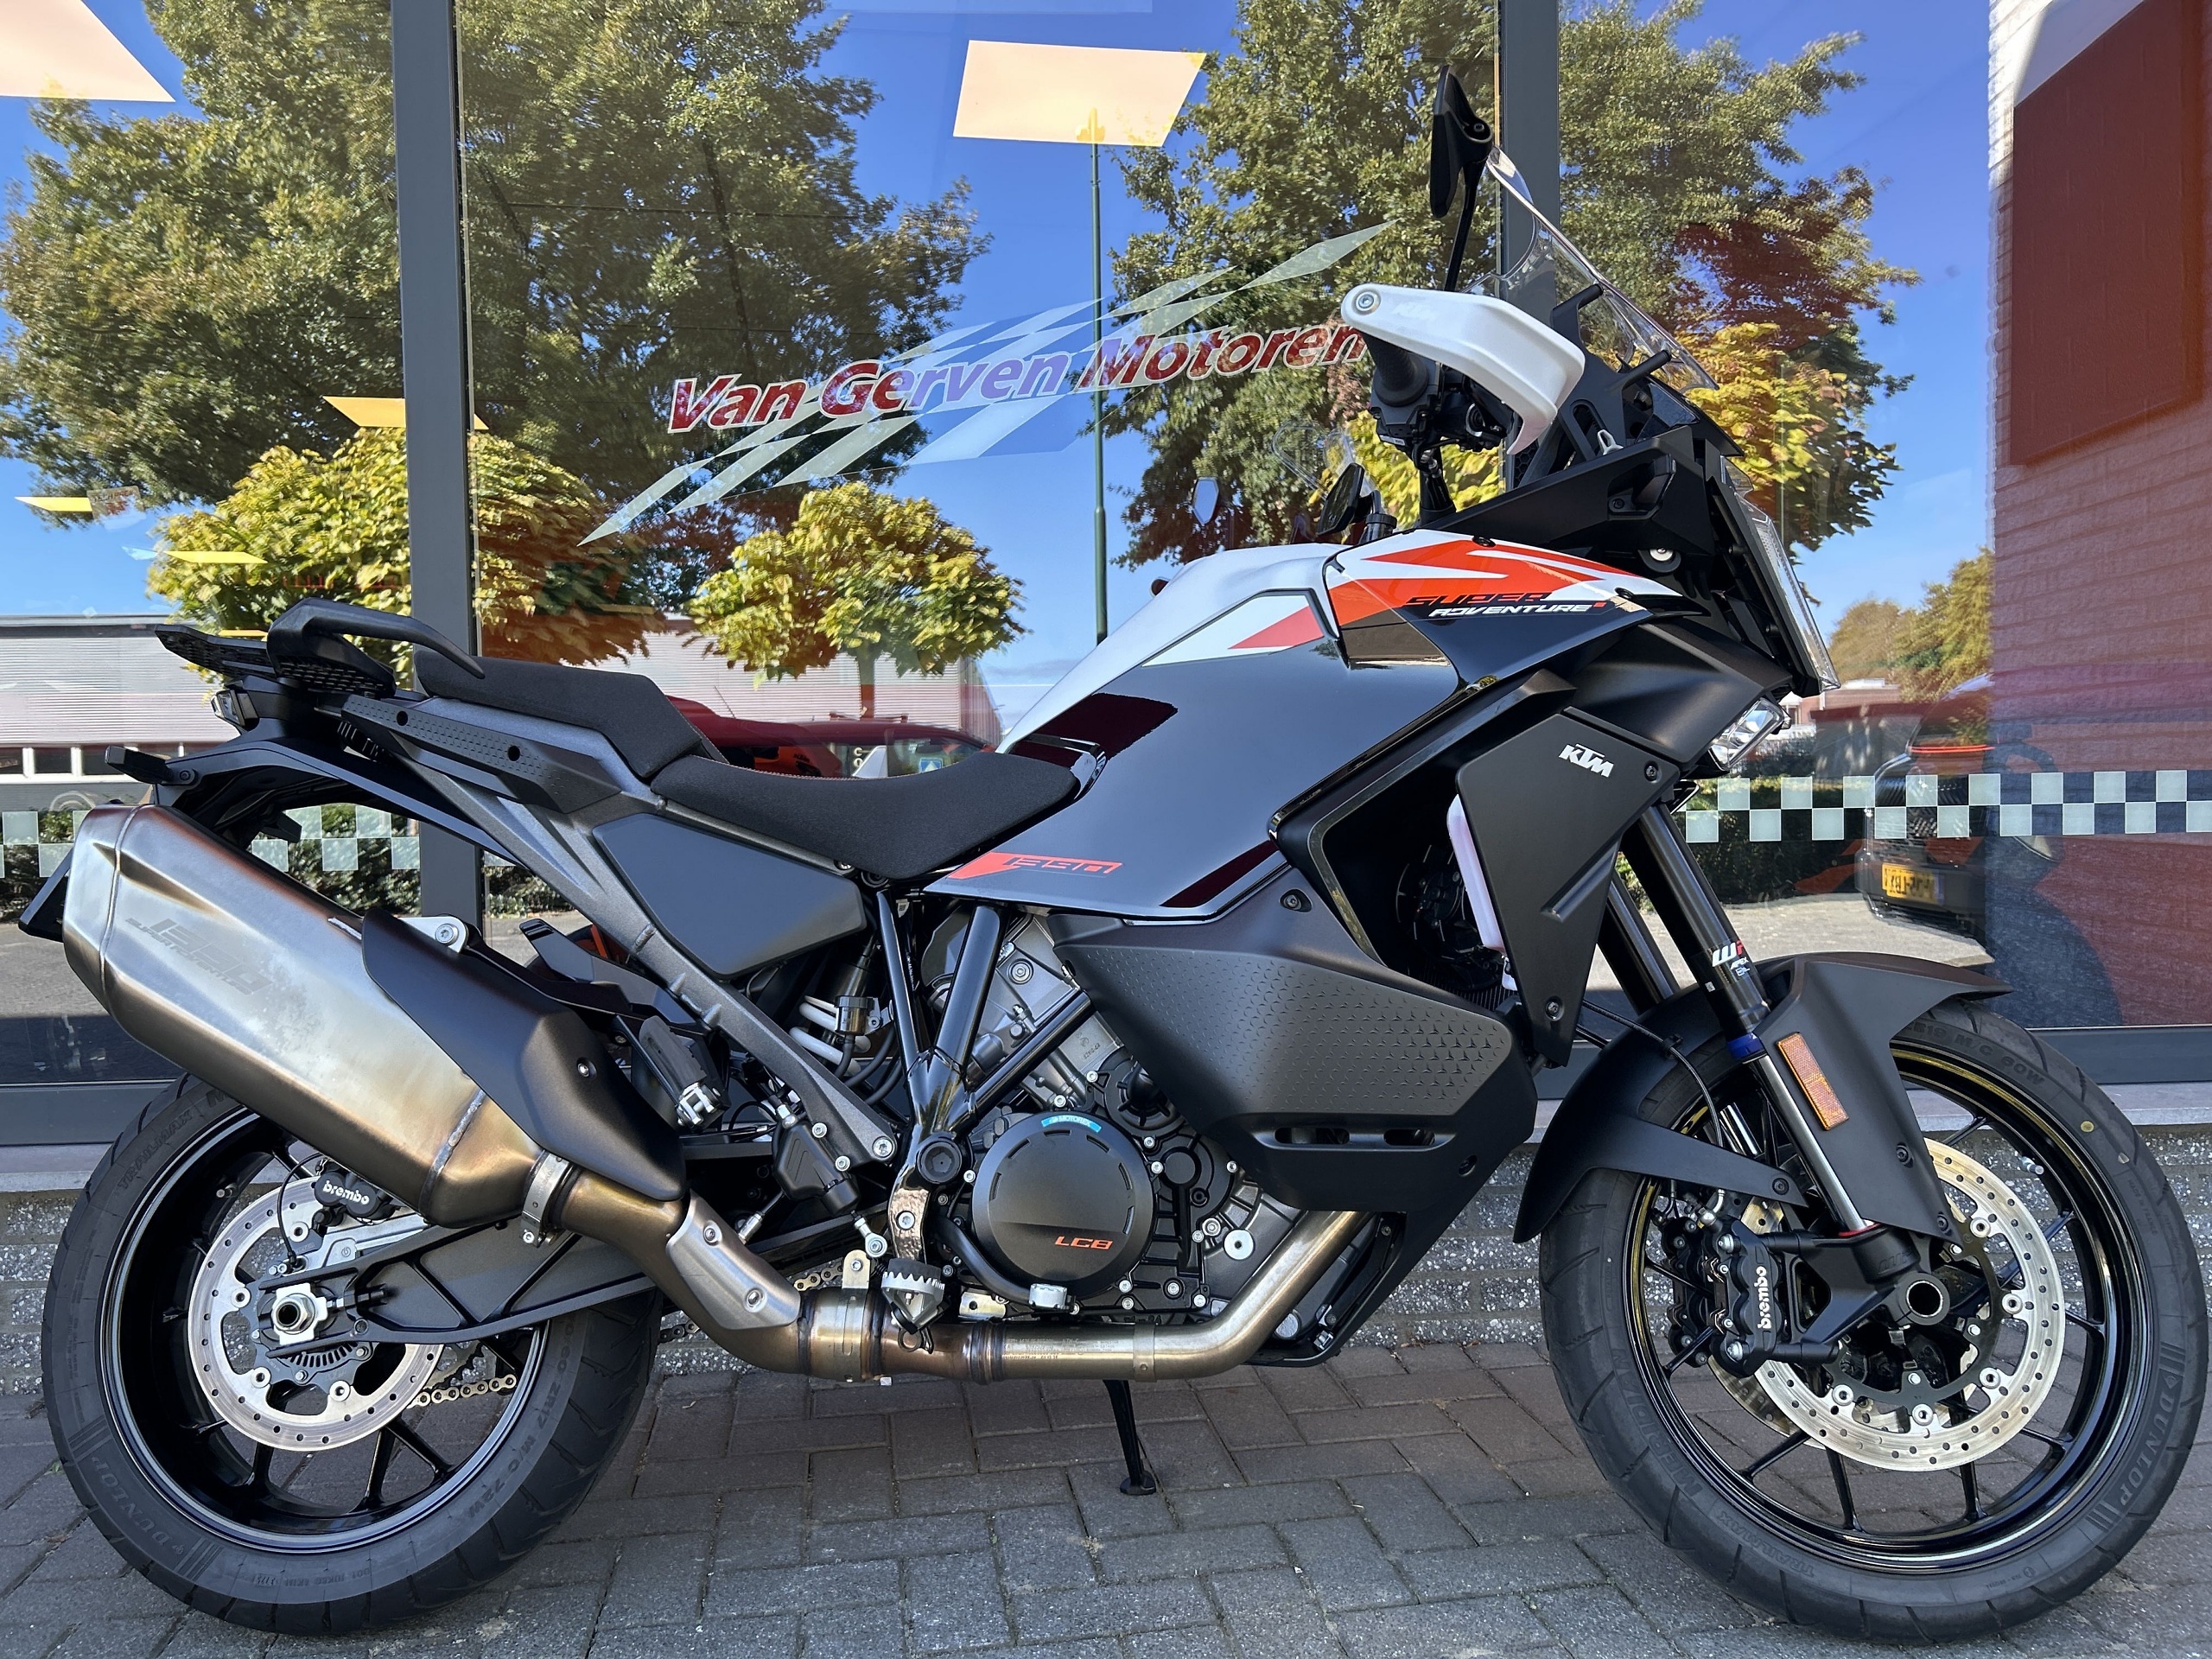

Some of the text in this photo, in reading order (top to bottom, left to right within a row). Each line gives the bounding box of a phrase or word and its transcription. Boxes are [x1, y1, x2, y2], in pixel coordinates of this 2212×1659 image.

[668, 322, 1367, 434] Van Gerven Motoren
[1406, 592, 1554, 606] SUPER
[1427, 603, 1593, 618] ADVENTURE
[1559, 743, 1614, 779] KTM
[117, 1110, 194, 1190] TRAILMAX
[322, 1180, 371, 1205] brembo
[1055, 1236, 1113, 1250] LC8
[1754, 1266, 1771, 1330] brembo
[1611, 1349, 1704, 1497] MERIDIAN
[2120, 1390, 2176, 1507] DUNLOP
[91, 1456, 172, 1548] DUNLOP
[1714, 1510, 1815, 1579] TRAILMAX
